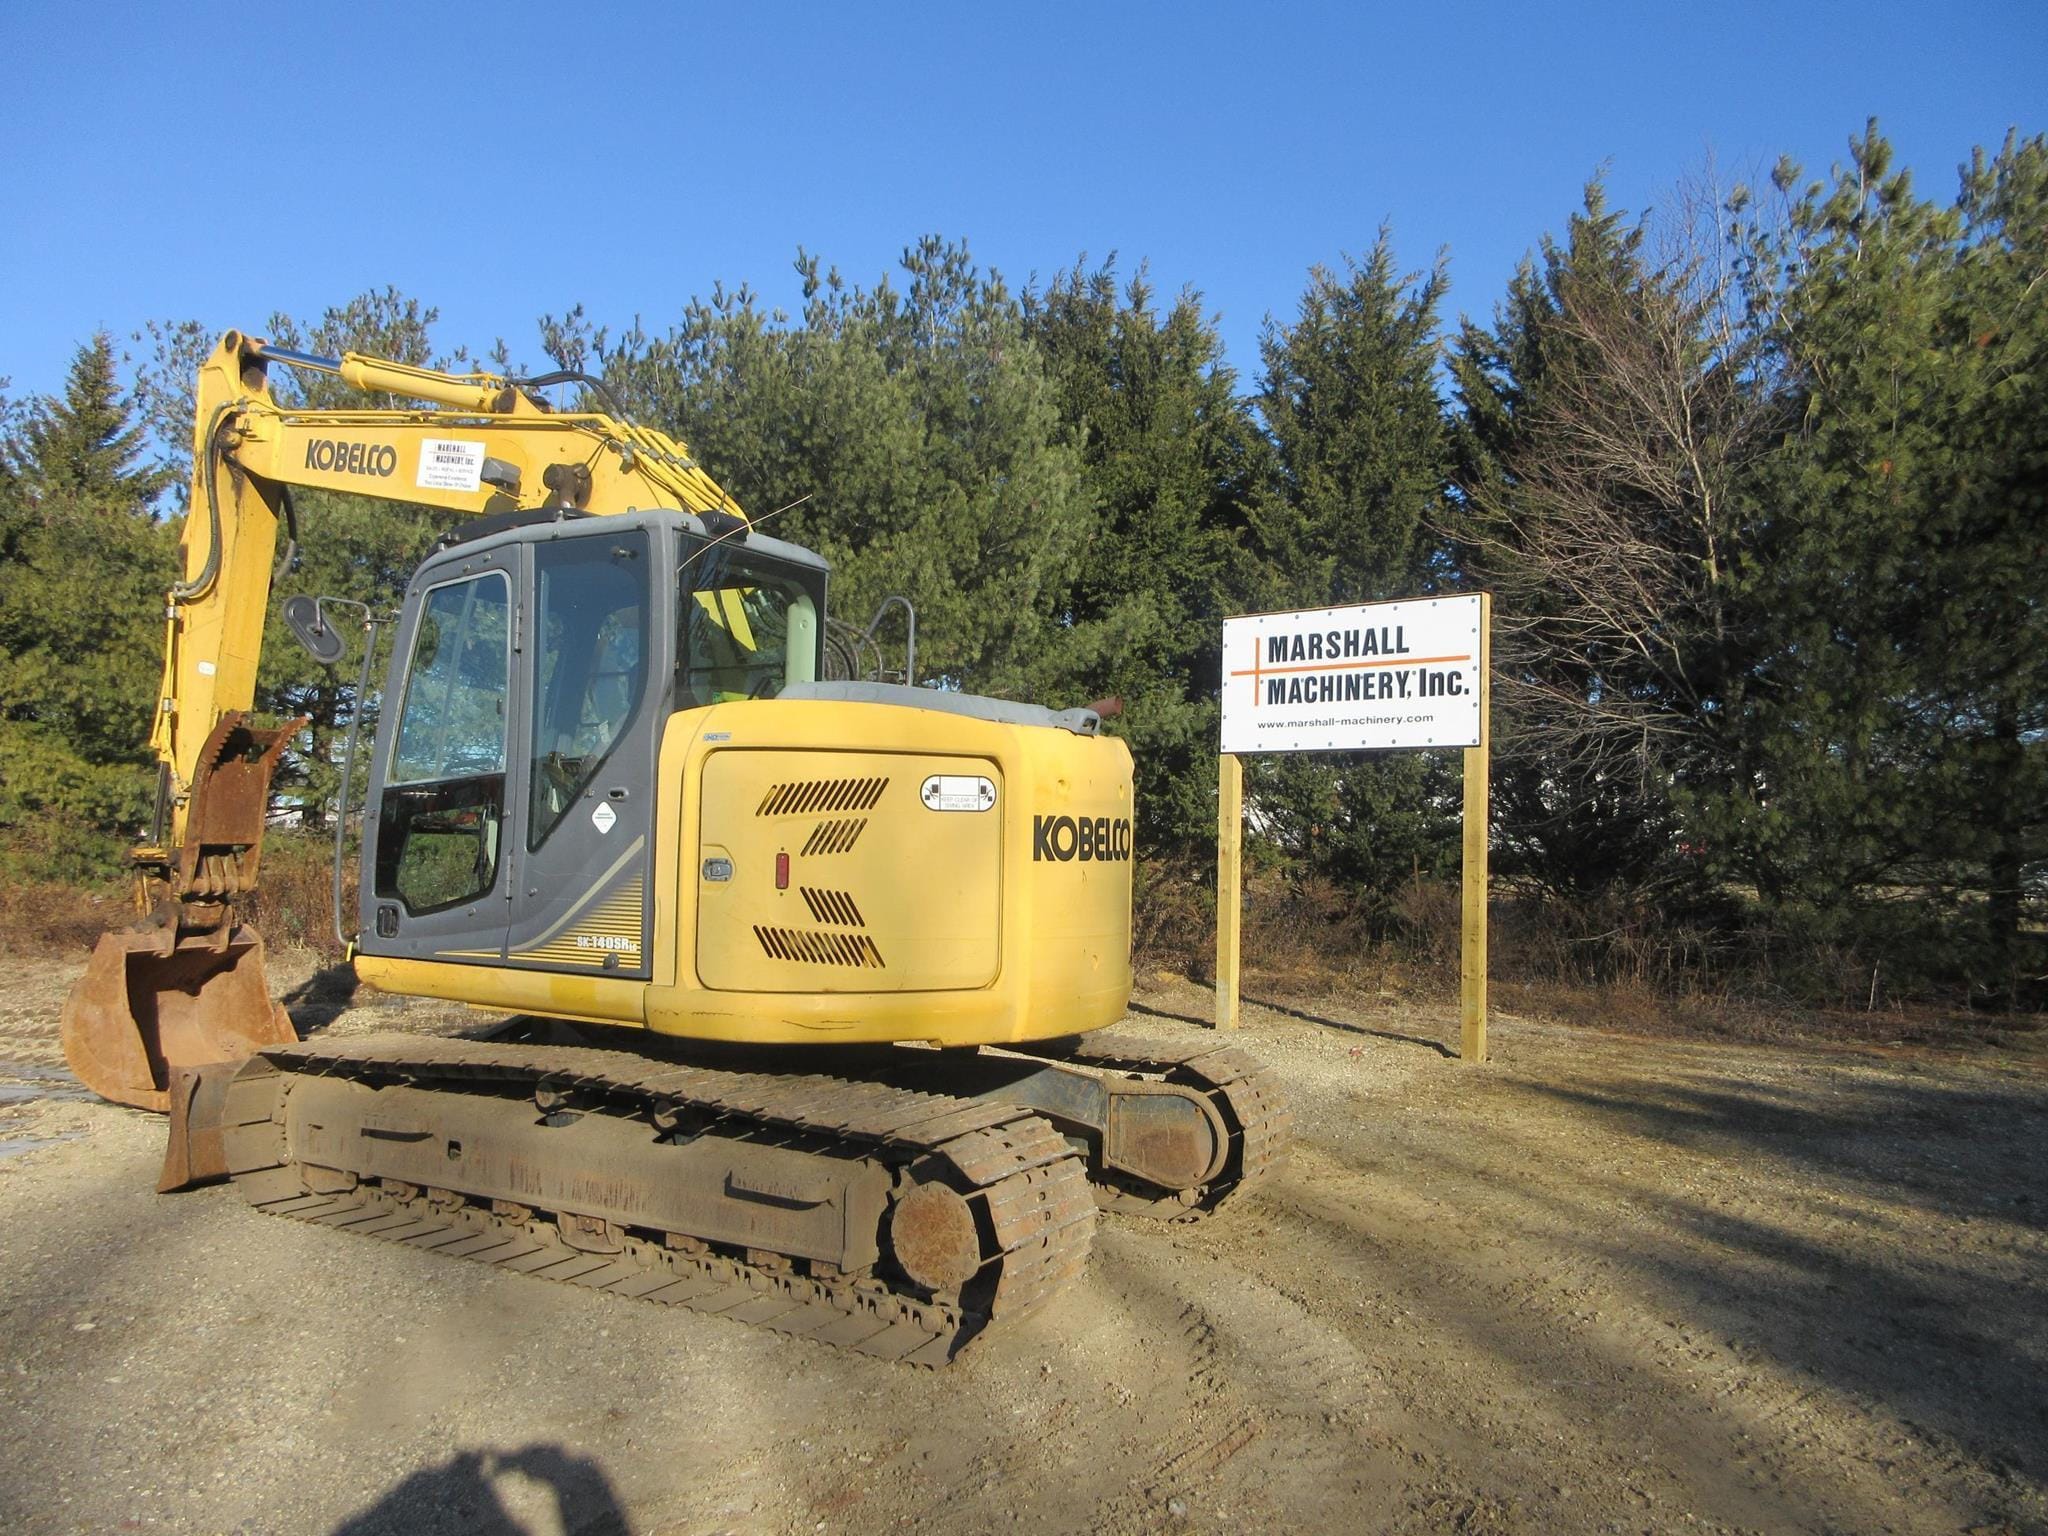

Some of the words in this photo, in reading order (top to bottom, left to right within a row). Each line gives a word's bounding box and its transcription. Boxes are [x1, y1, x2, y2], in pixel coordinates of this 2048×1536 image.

[304, 438, 397, 477] KOBELCO
[437, 443, 466, 453] MARSHALL
[1268, 625, 1410, 663] MARSHALL
[1267, 670, 1412, 705] MACHINERY,
[1419, 668, 1470, 698] Inc.
[1257, 713, 1434, 730] www.marshall-machinery.com
[1033, 815, 1131, 862] KOBELCO
